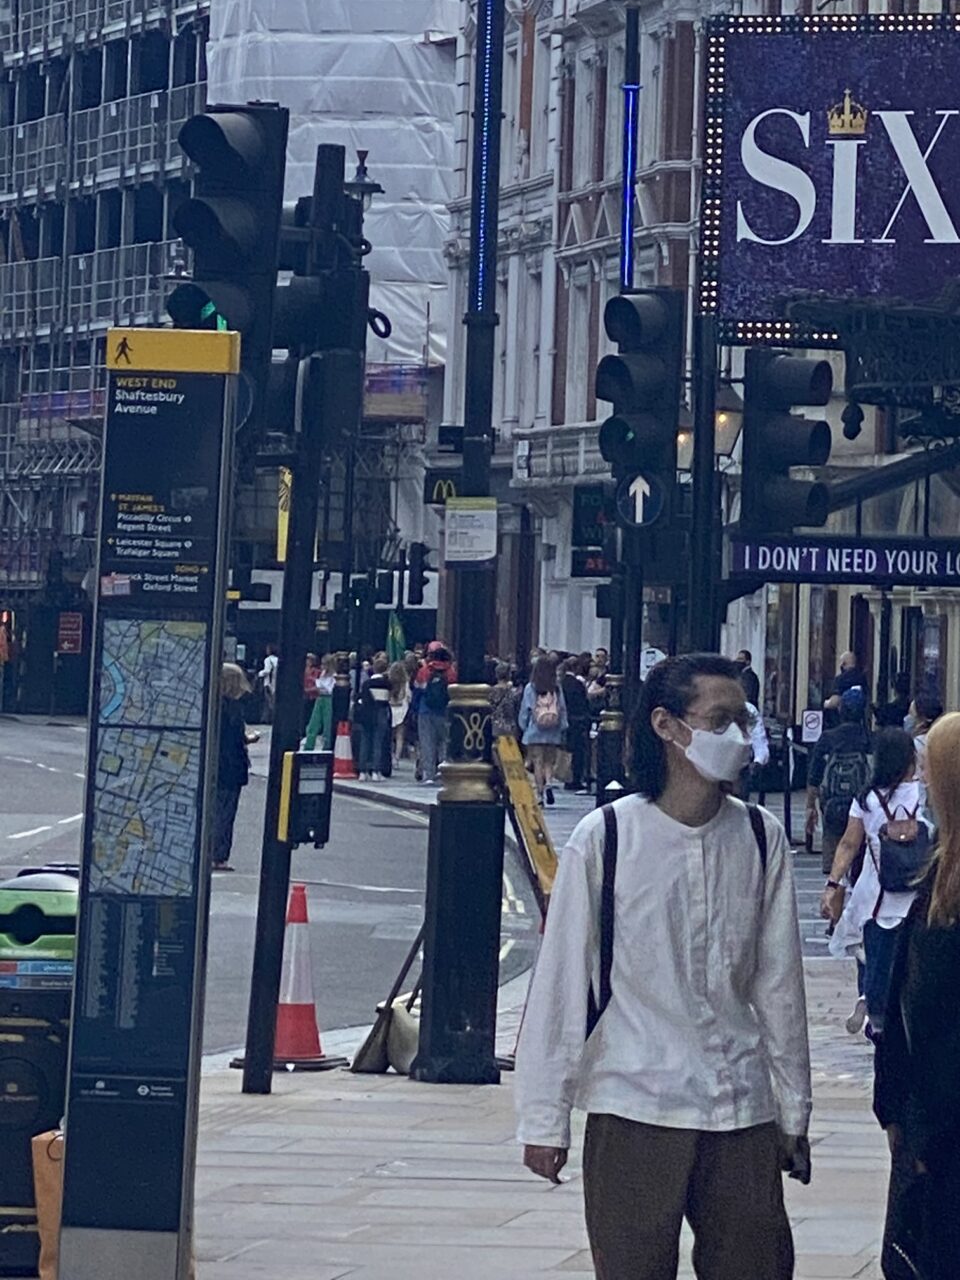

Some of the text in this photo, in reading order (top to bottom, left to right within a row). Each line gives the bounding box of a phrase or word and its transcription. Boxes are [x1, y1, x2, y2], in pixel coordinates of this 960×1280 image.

[116, 377, 177, 389] WEST END
[115, 389, 185, 405] Shaftesbury
[114, 403, 158, 415] Avenue
[147, 523, 171, 532] Street
[116, 538, 182, 549] Leicester Square
[152, 549, 180, 559] Square
[744, 545, 750, 570] I
[757, 546, 820, 572] DON'T
[826, 548, 877, 573] NEED
[884, 549, 939, 575] YOUR
[144, 573, 169, 582] Street
[142, 583, 198, 593] Oxford Street
